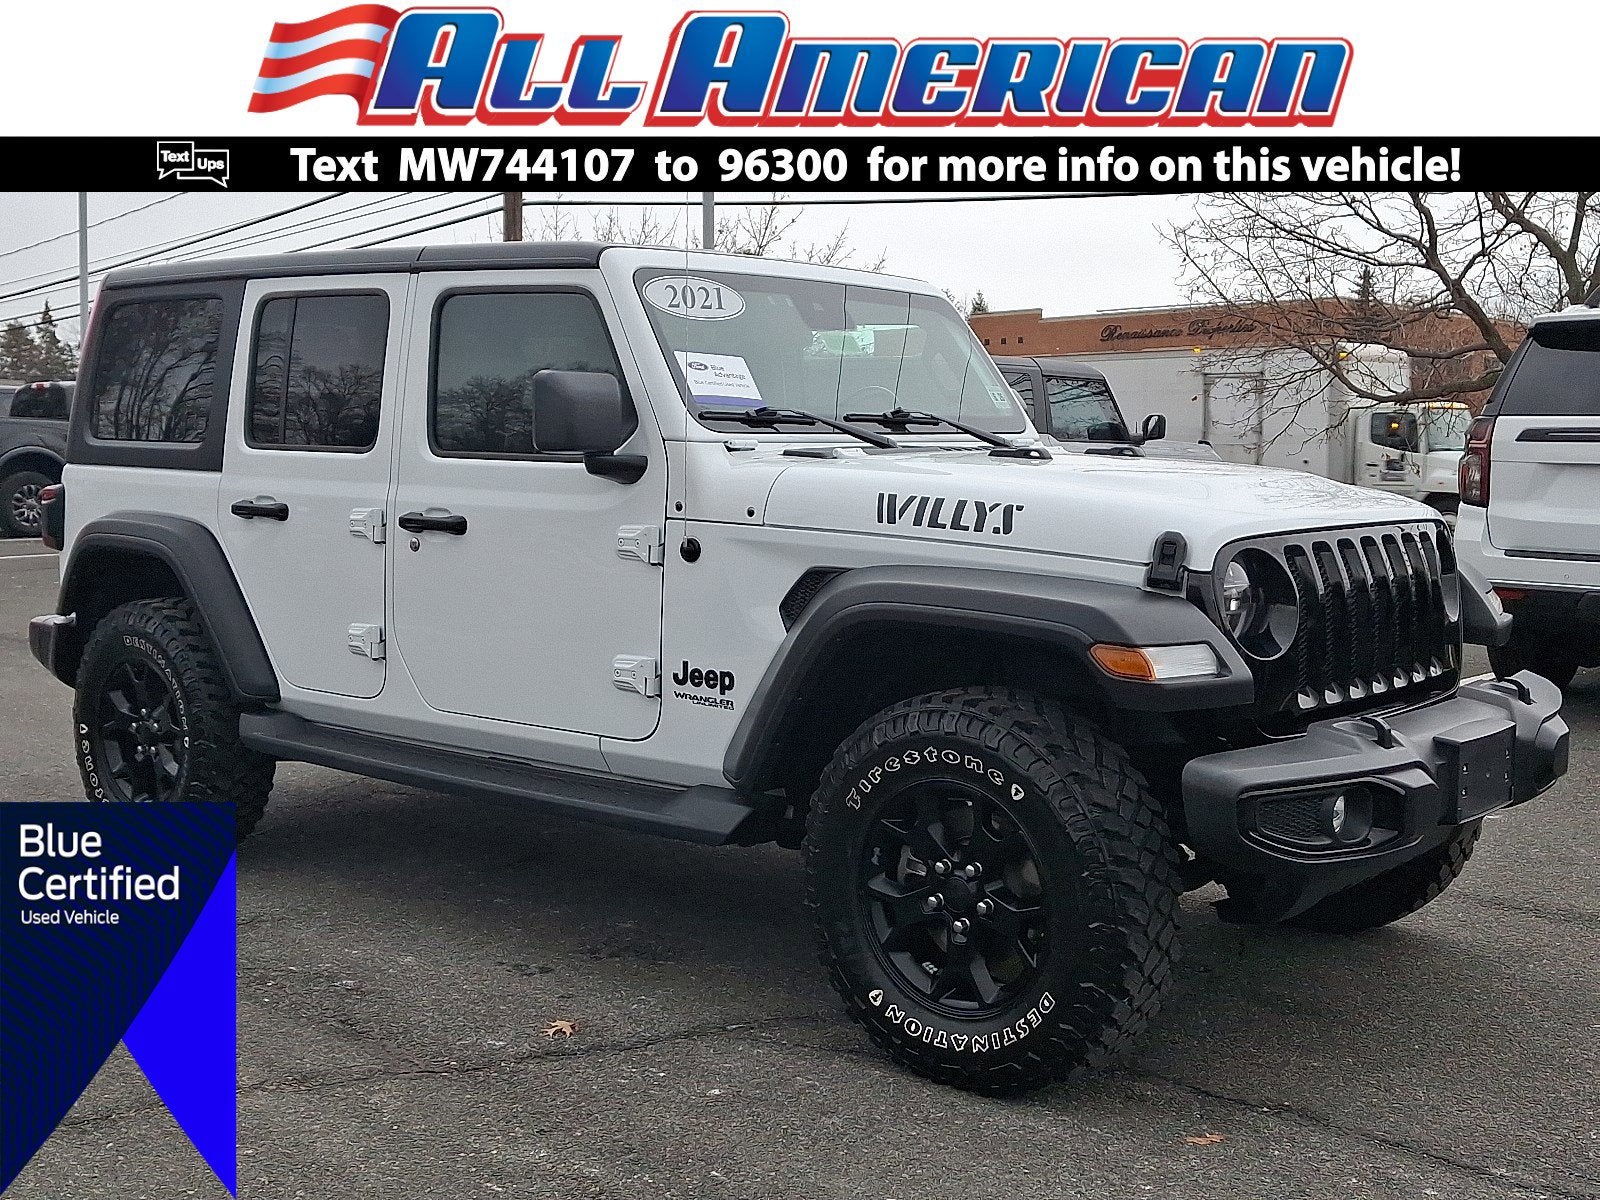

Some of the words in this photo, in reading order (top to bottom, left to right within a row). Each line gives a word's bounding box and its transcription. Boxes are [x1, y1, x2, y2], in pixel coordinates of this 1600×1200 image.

[664, 284, 726, 311] 2021
[877, 492, 1025, 535] WILLYS
[672, 660, 735, 695] Jeep
[673, 690, 734, 707] WRANGLER
[845, 746, 1004, 810] Firestone
[885, 991, 1055, 1053] DESTINATION
